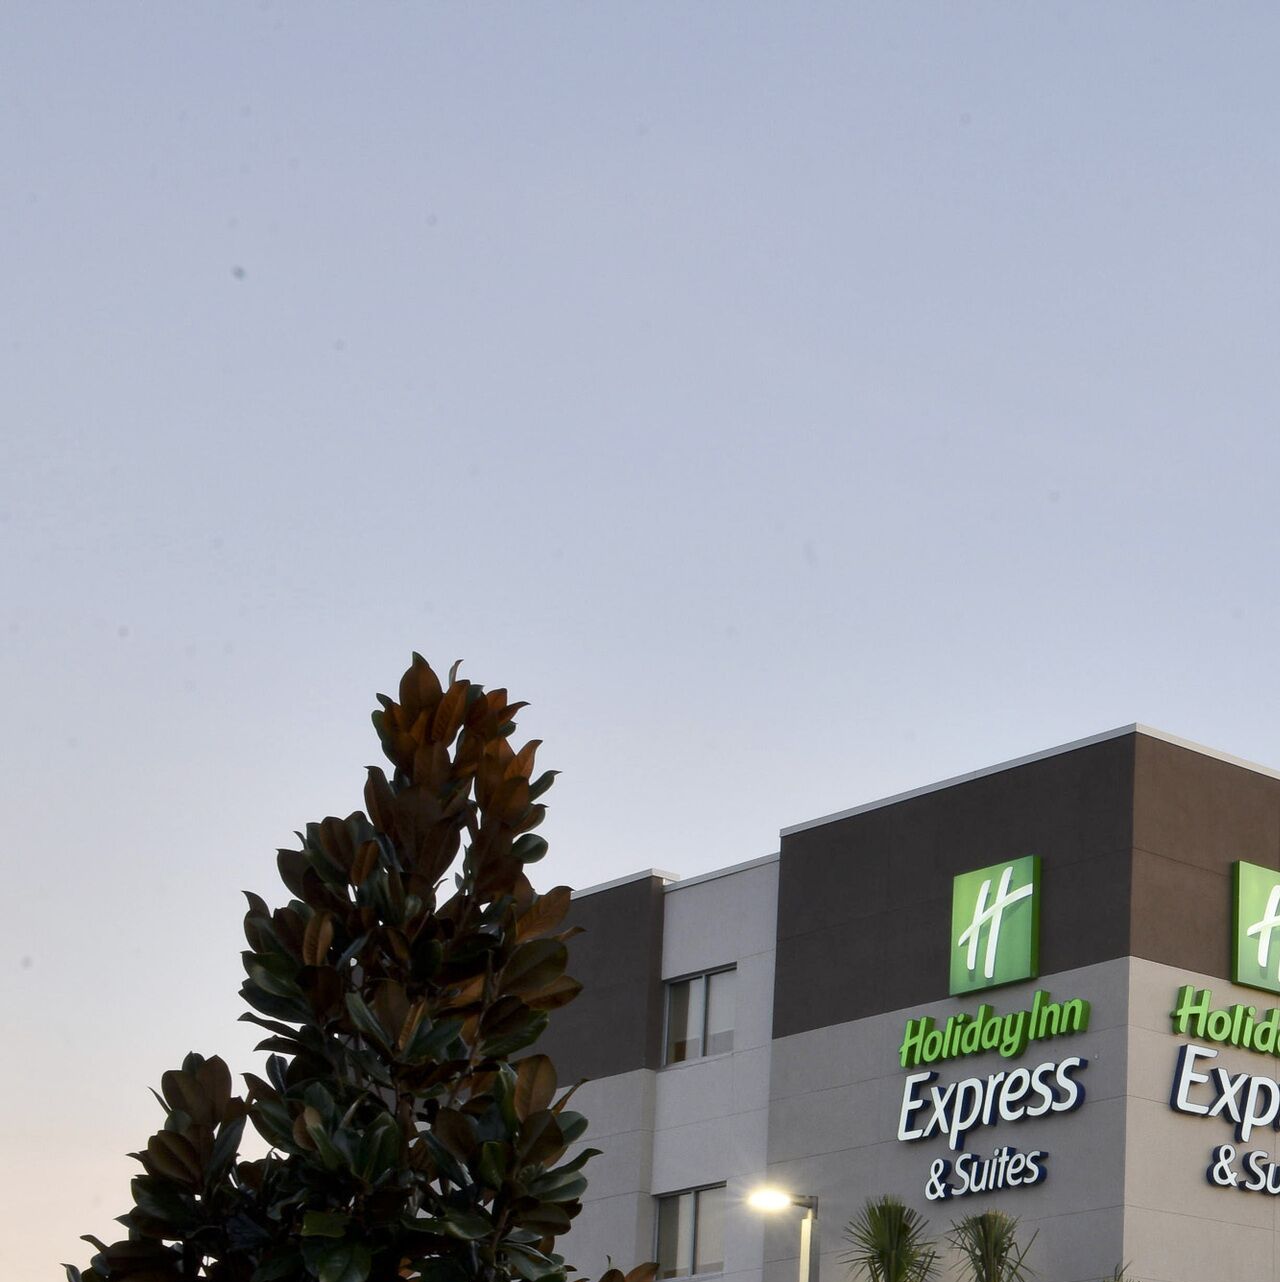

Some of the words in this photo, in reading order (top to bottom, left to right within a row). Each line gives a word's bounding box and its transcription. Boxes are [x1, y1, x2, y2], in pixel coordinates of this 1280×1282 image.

[899, 1003, 1026, 1068] Holiday
[1028, 990, 1088, 1041] Inn
[898, 1056, 1085, 1151] Express
[924, 1158, 949, 1201] &
[951, 1146, 1045, 1196] Suites
[1210, 1144, 1239, 1187] &
